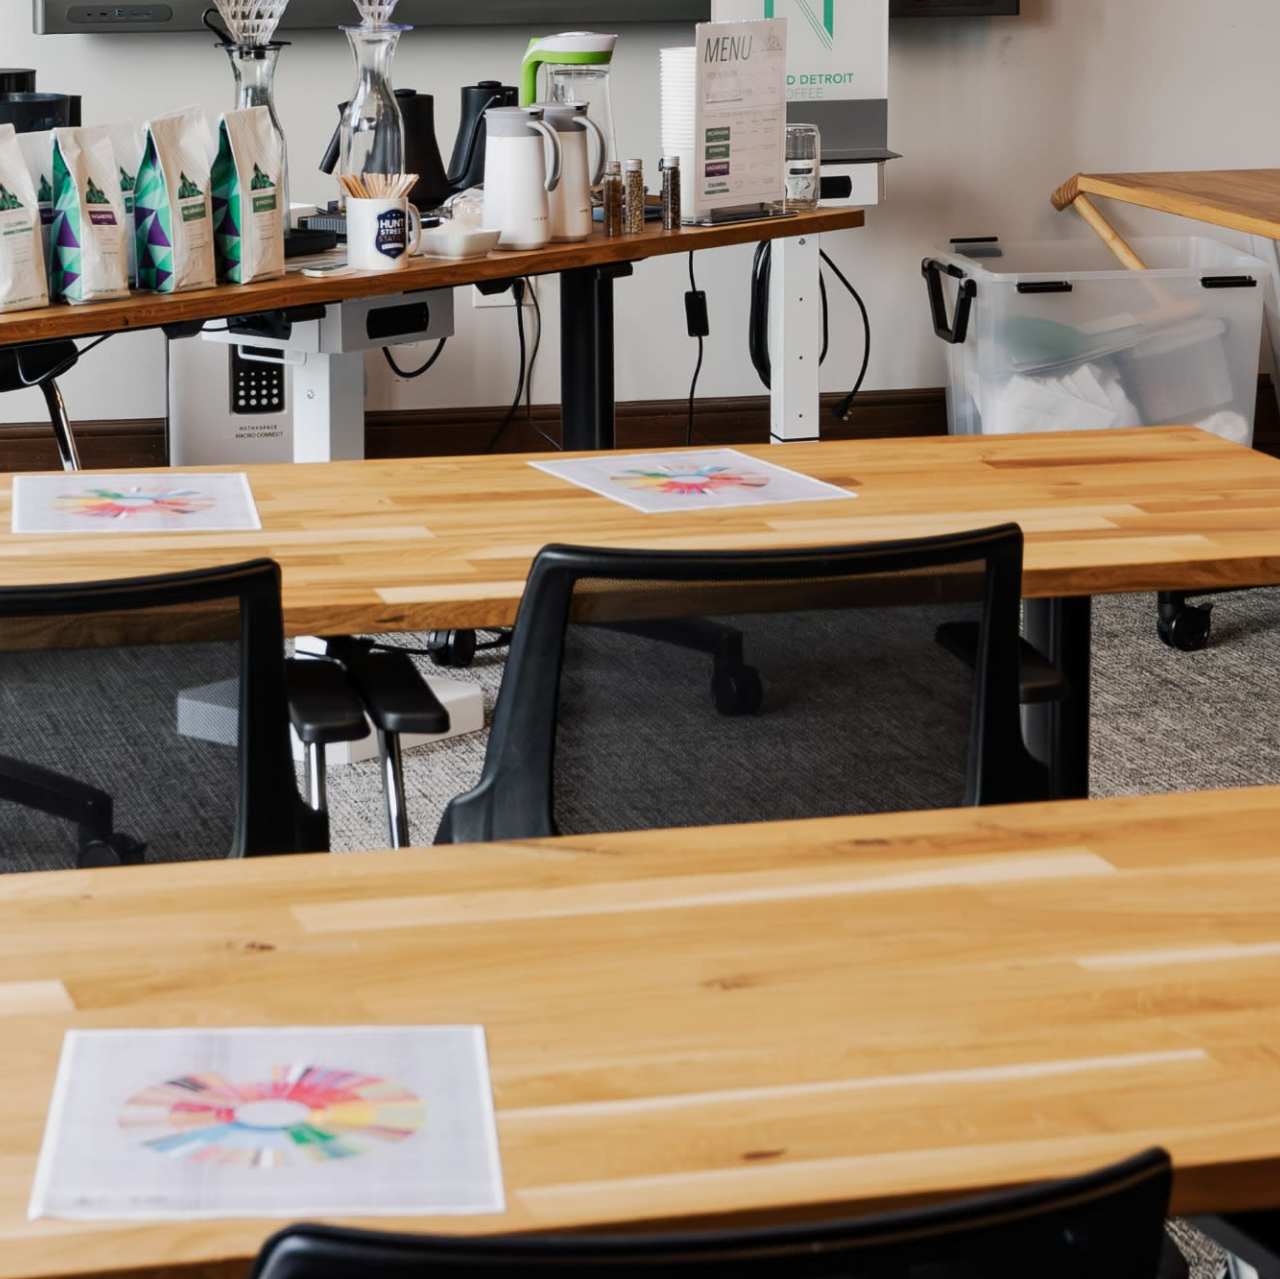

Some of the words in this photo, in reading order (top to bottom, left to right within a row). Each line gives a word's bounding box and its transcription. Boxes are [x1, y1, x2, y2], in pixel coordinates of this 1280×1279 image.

[704, 34, 753, 63] MENU
[799, 72, 855, 85] DETROIT
[785, 87, 824, 99] OFFEE
[380, 218, 404, 229] HUNT
